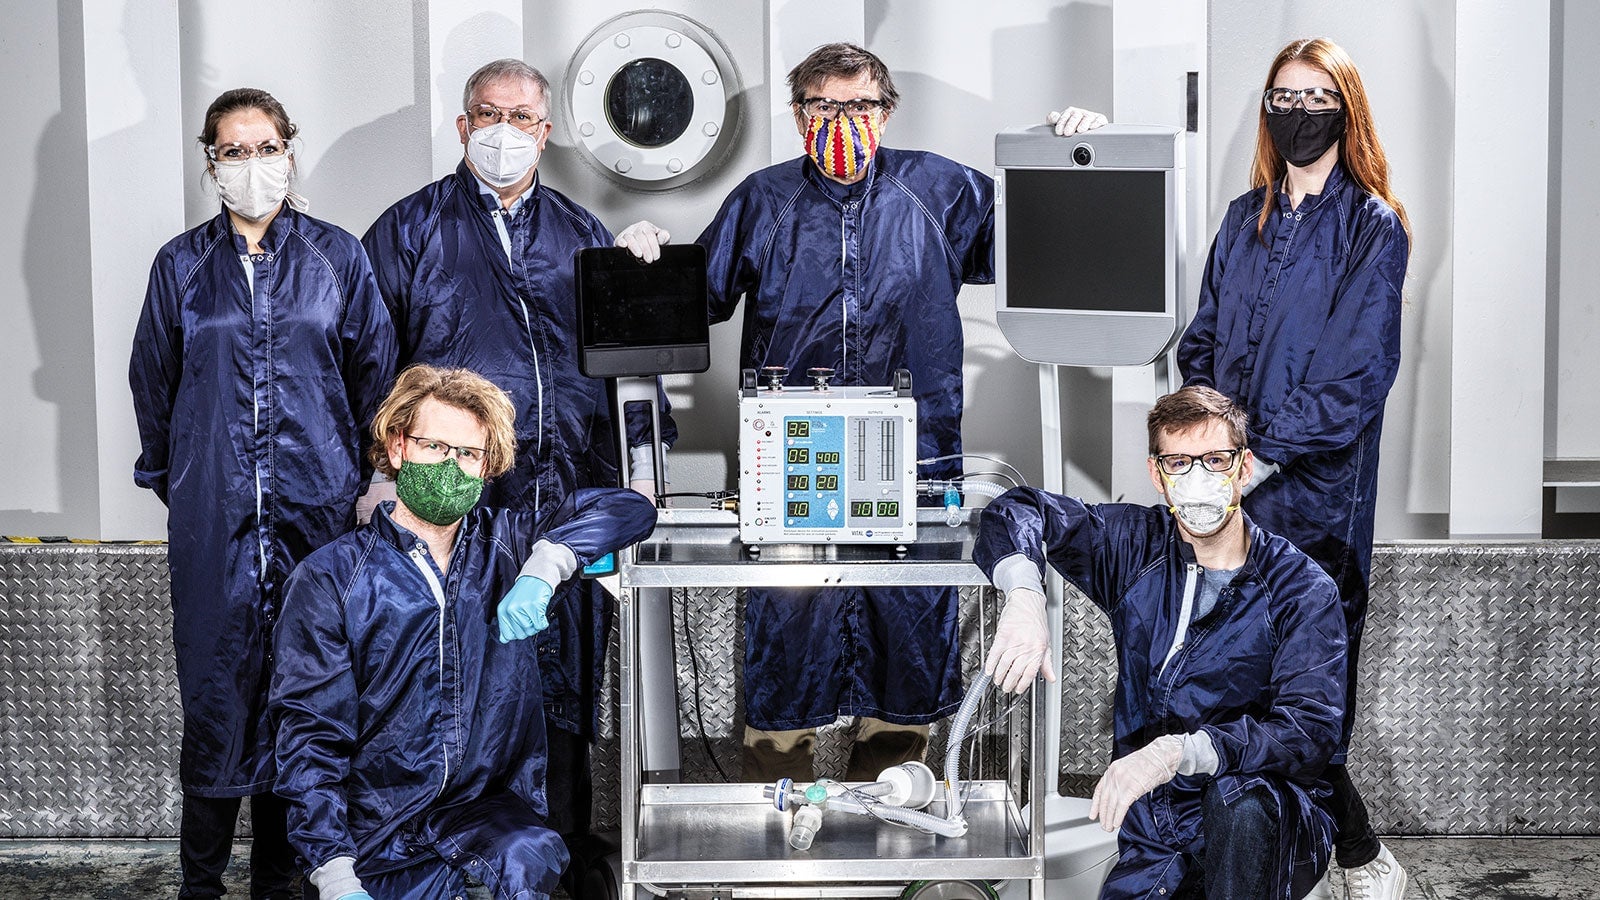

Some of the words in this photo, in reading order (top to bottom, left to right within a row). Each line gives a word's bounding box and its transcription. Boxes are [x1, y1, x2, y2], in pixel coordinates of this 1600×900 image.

[788, 422, 809, 436] 32
[788, 449, 808, 463] 05
[817, 453, 839, 463] 400
[794, 476, 809, 489] 10
[816, 476, 837, 489] 20
[794, 503, 809, 516] 1.0
[857, 502, 872, 516] 10
[877, 502, 898, 516] 00
